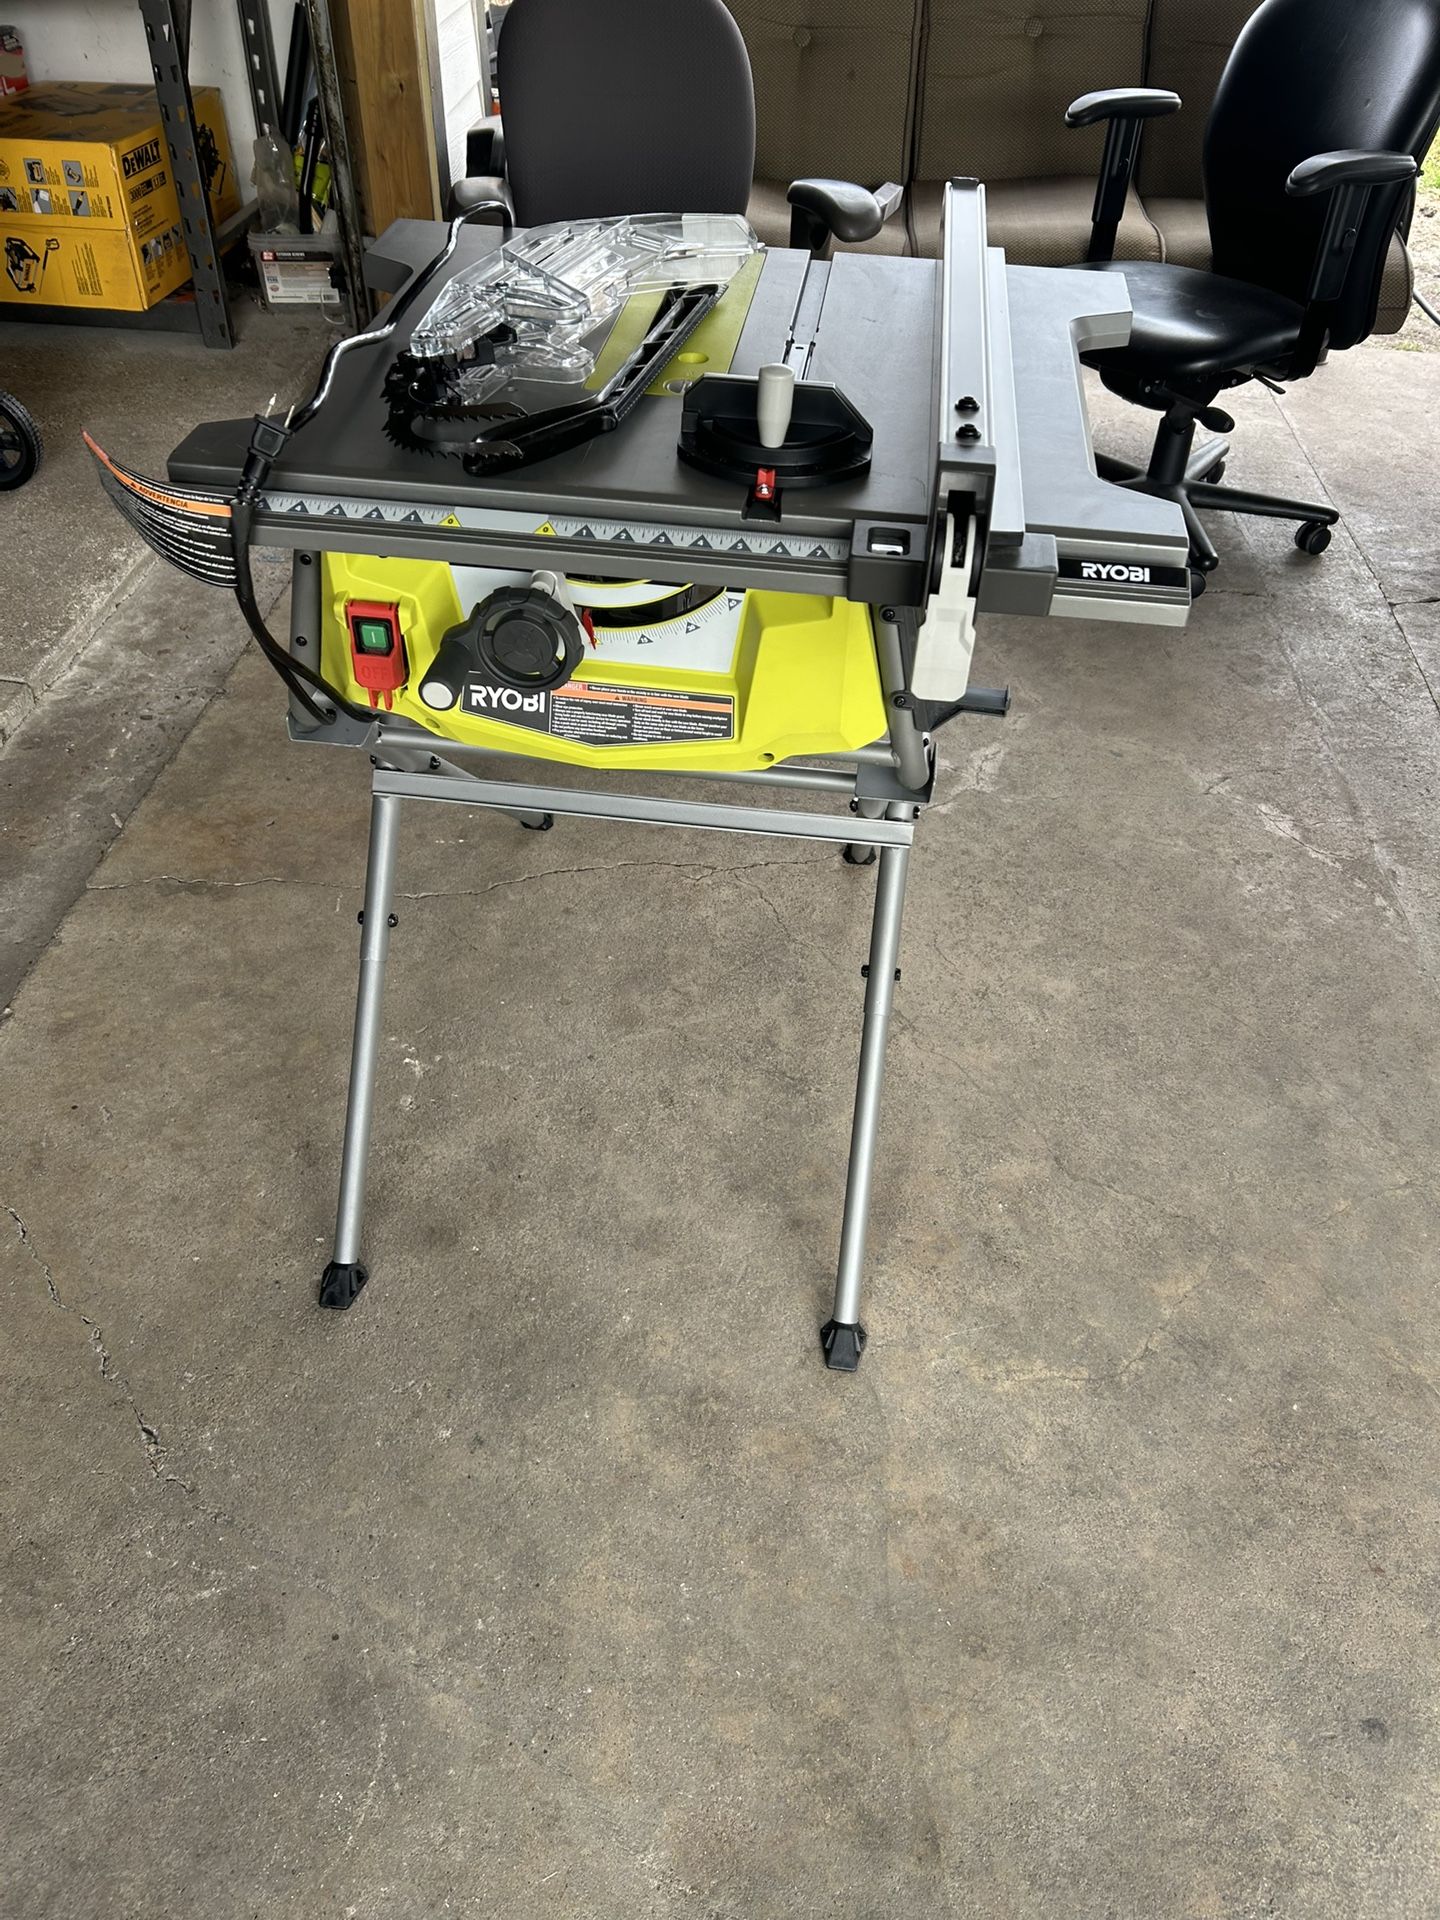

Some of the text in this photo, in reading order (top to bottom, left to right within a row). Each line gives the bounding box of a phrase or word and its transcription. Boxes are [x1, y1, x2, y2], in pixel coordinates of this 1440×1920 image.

[121, 140, 160, 177] DEWALT
[139, 486, 189, 509] ADVERTENCIA
[1081, 562, 1150, 582] RYOBI
[469, 684, 546, 713] RYOBI
[622, 695, 647, 704] WARNING
